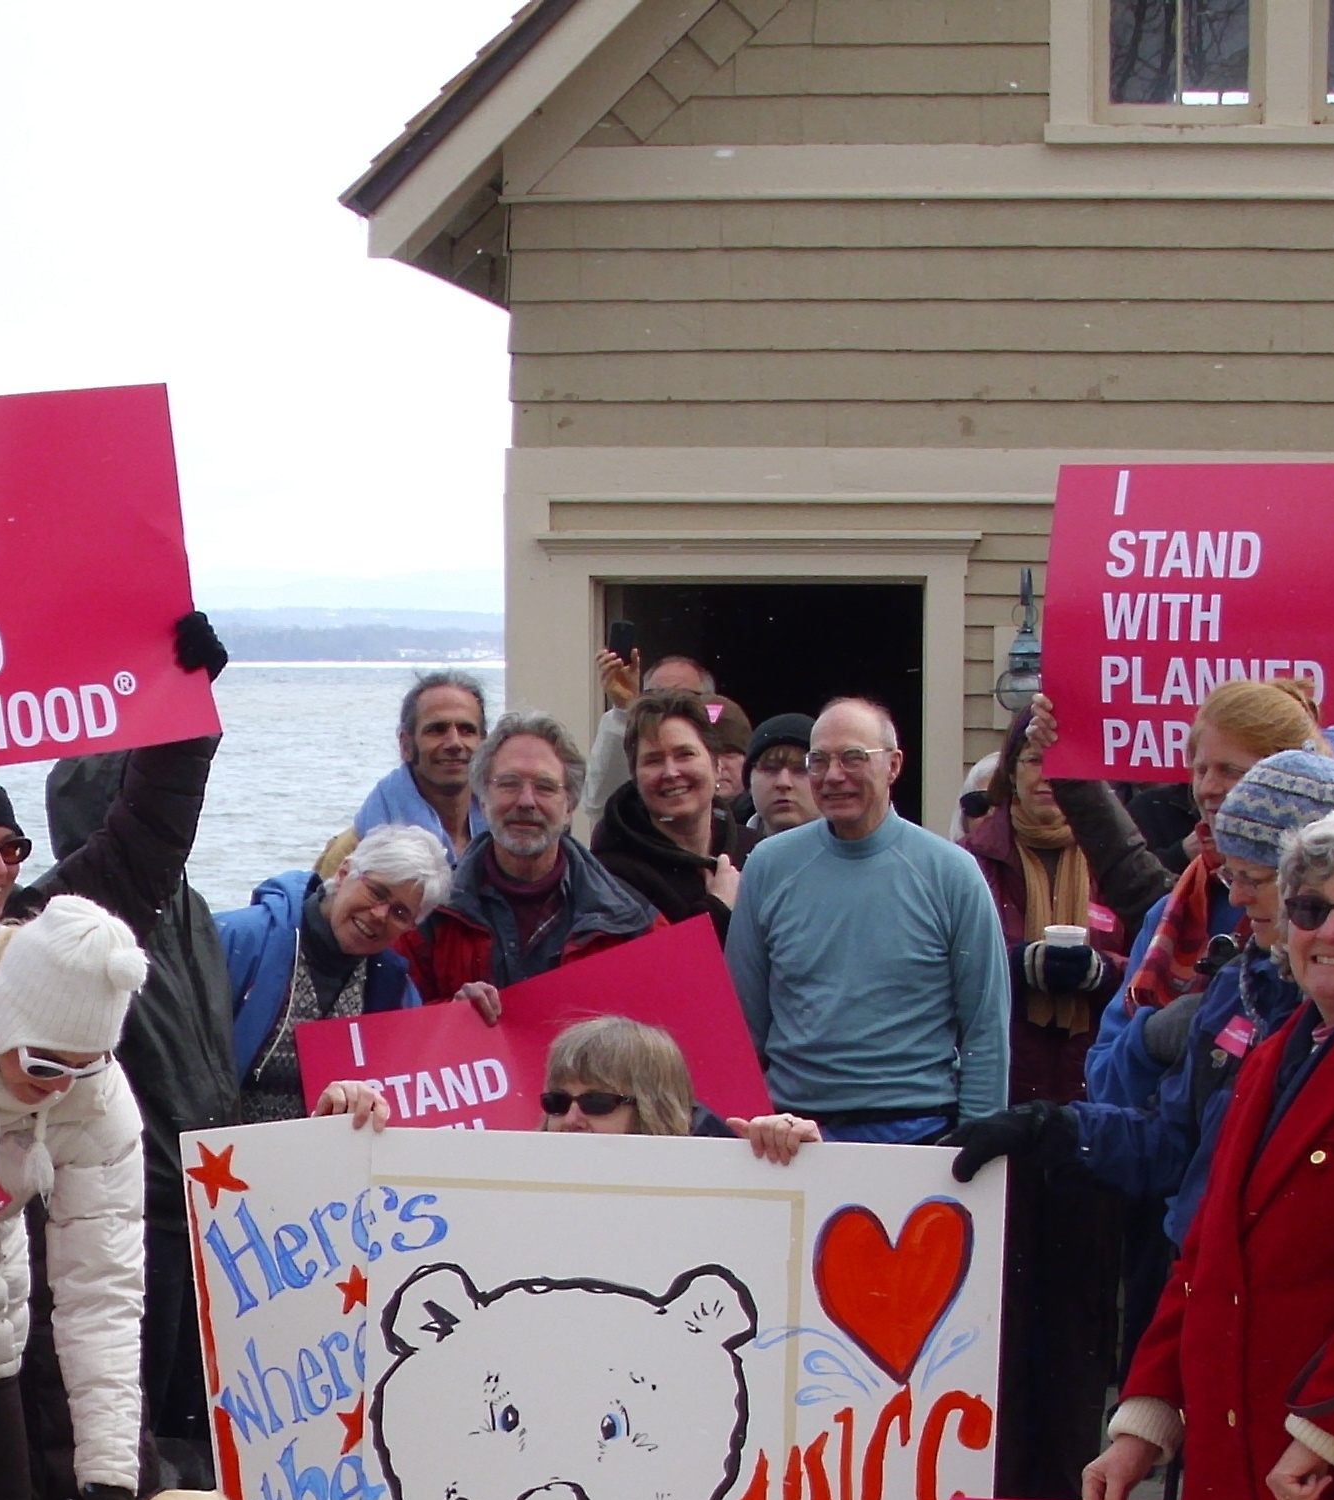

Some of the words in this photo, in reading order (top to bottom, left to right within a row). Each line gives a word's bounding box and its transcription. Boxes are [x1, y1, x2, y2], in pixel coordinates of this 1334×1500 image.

[1113, 470, 1130, 516] I
[1105, 529, 1262, 579] STAND
[1102, 592, 1221, 642] WITH
[348, 1022, 365, 1067] I
[365, 1058, 509, 1119] TAND
